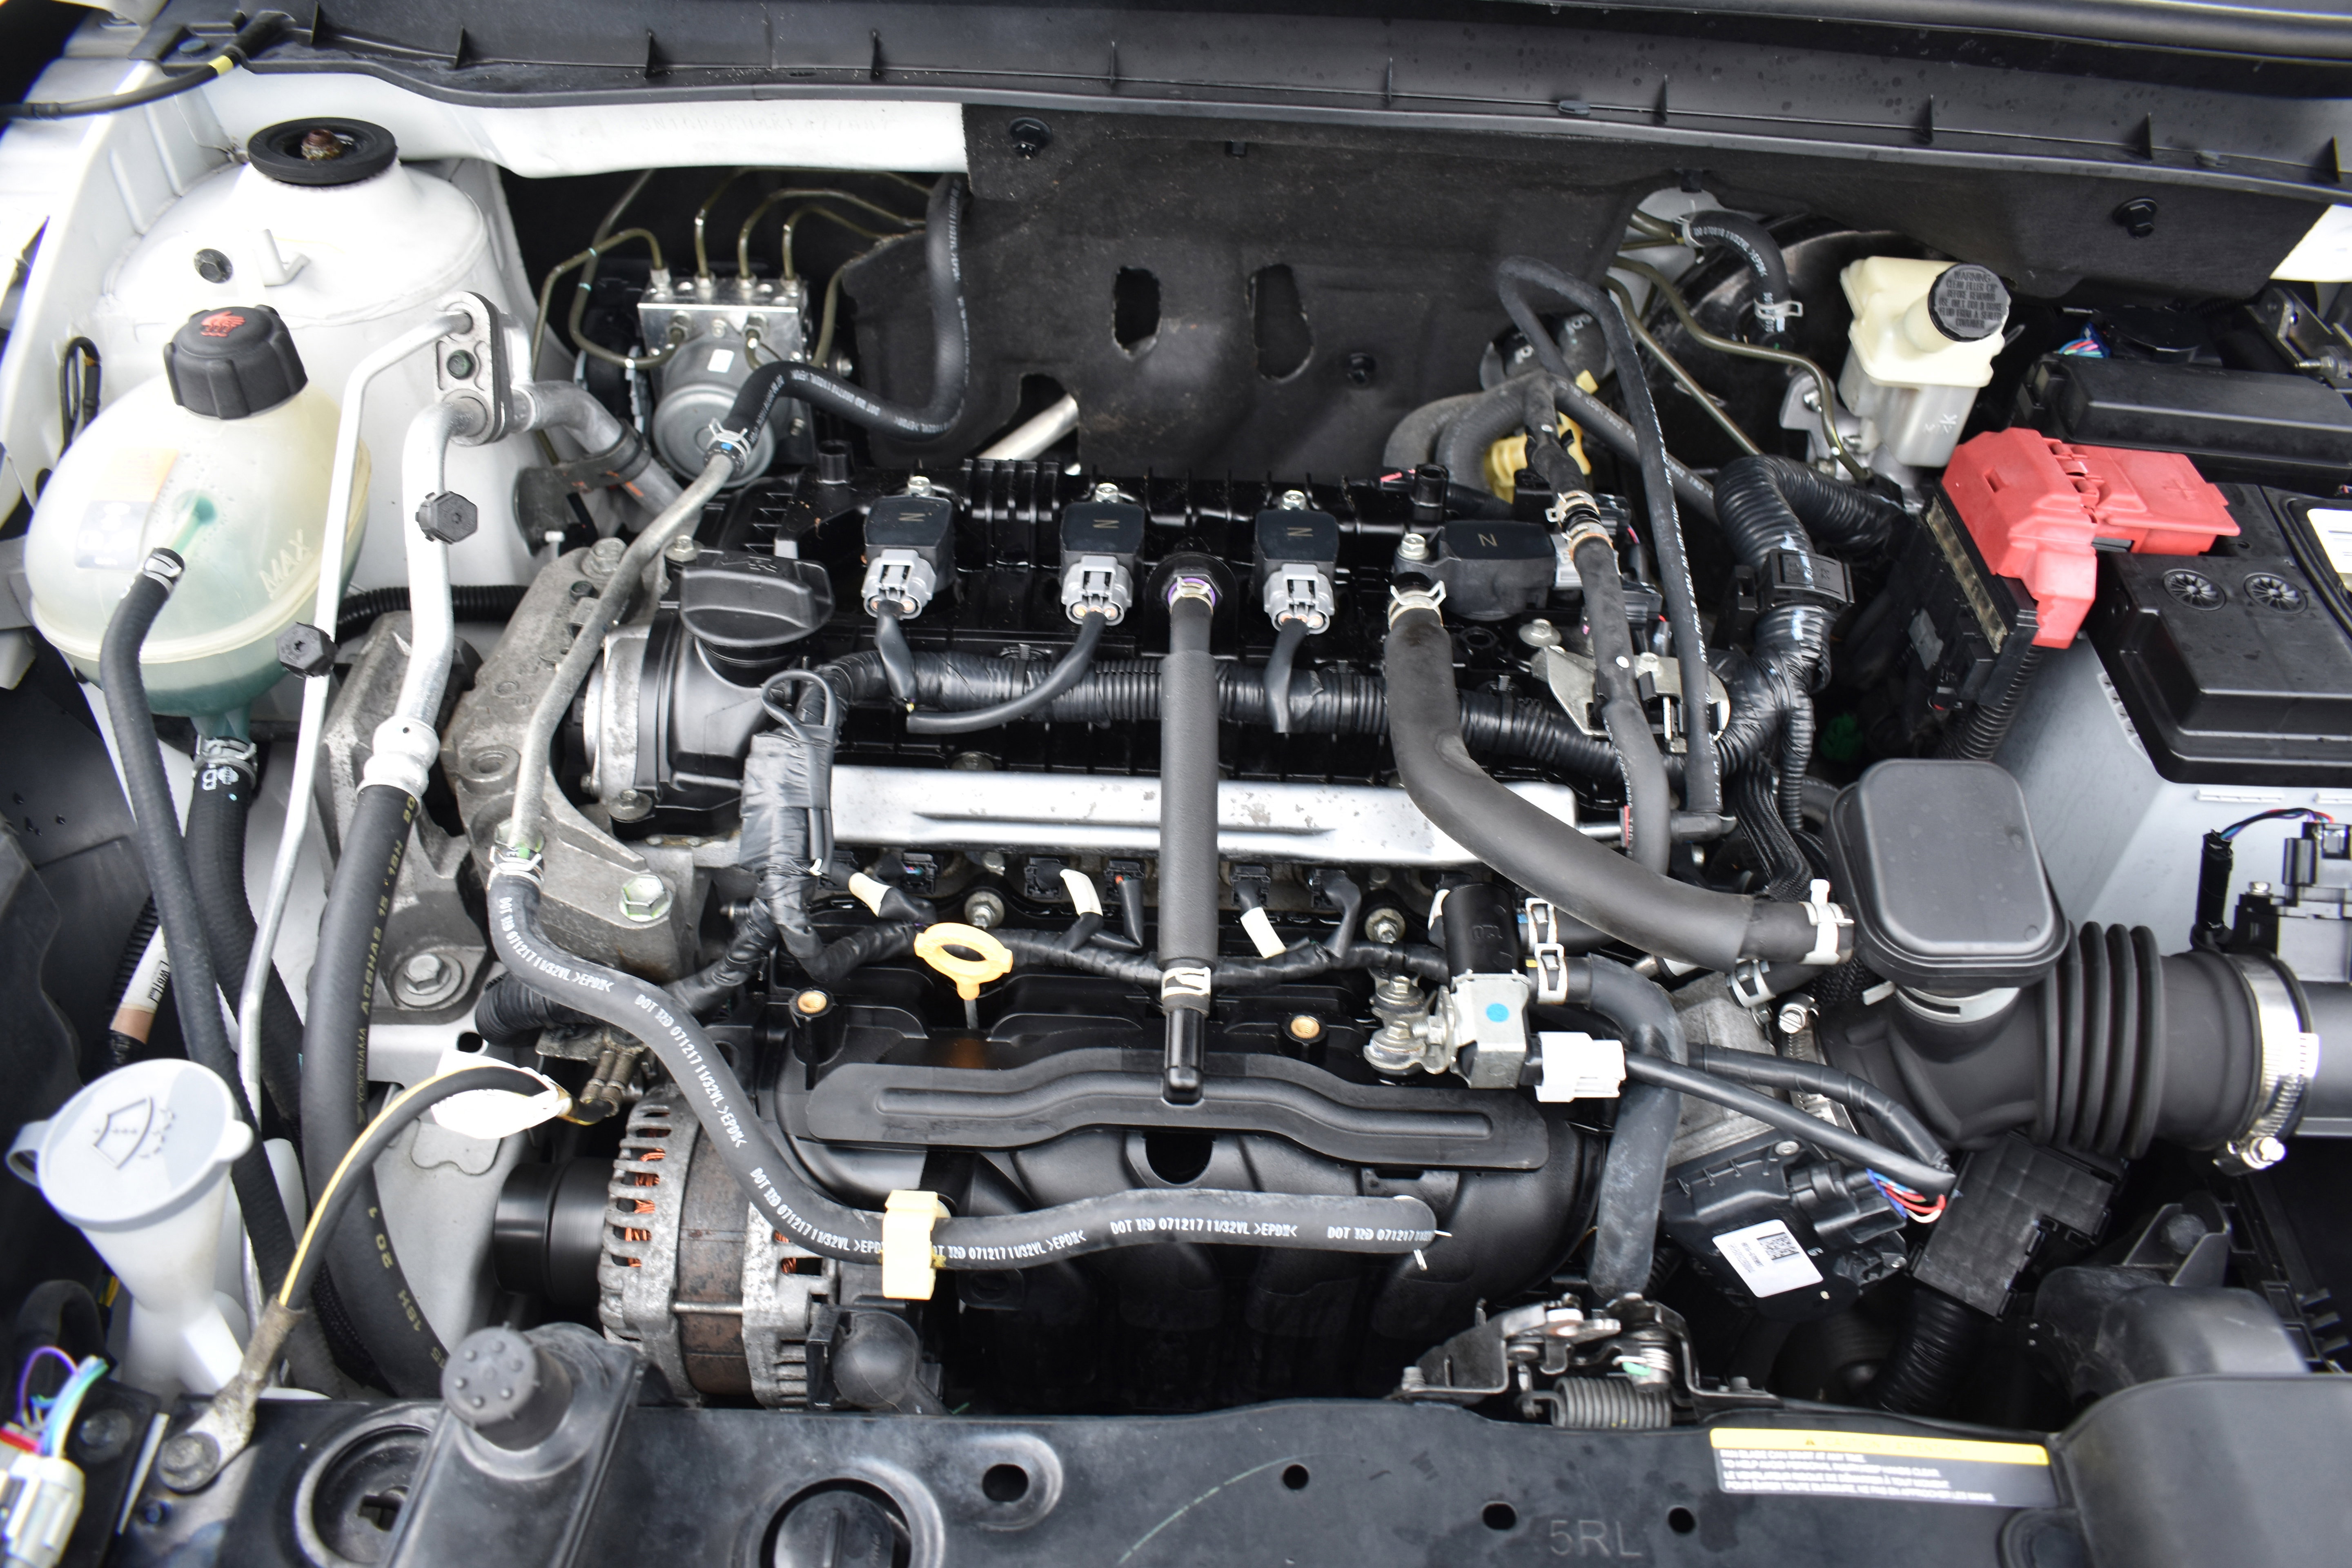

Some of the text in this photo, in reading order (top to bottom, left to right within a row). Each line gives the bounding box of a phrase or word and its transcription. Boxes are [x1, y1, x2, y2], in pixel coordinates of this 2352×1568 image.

[1954, 271, 1991, 282] WARNING
[1477, 533, 1498, 547] N
[259, 529, 311, 594] MAX
[499, 897, 512, 914] DOT
[506, 931, 537, 962] 071217
[635, 994, 659, 1012] DOT
[670, 1026, 703, 1065] 071217
[356, 1027, 367, 1104] YOKOHAMA
[750, 1167, 771, 1189] DOT
[777, 1204, 813, 1236] 071217
[1110, 1219, 1132, 1234] DOT
[1159, 1217, 1204, 1231] 071217
[1327, 1226, 1351, 1239] DOT
[1376, 1229, 1414, 1241] 071217
[376, 1232, 393, 1269] 20
[969, 1247, 1005, 1260] 071217
[1824, 1437, 1880, 1448] CAUTION
[1896, 1442, 1961, 1453] ATTENTION
[1550, 1519, 1642, 1557] 5RL
